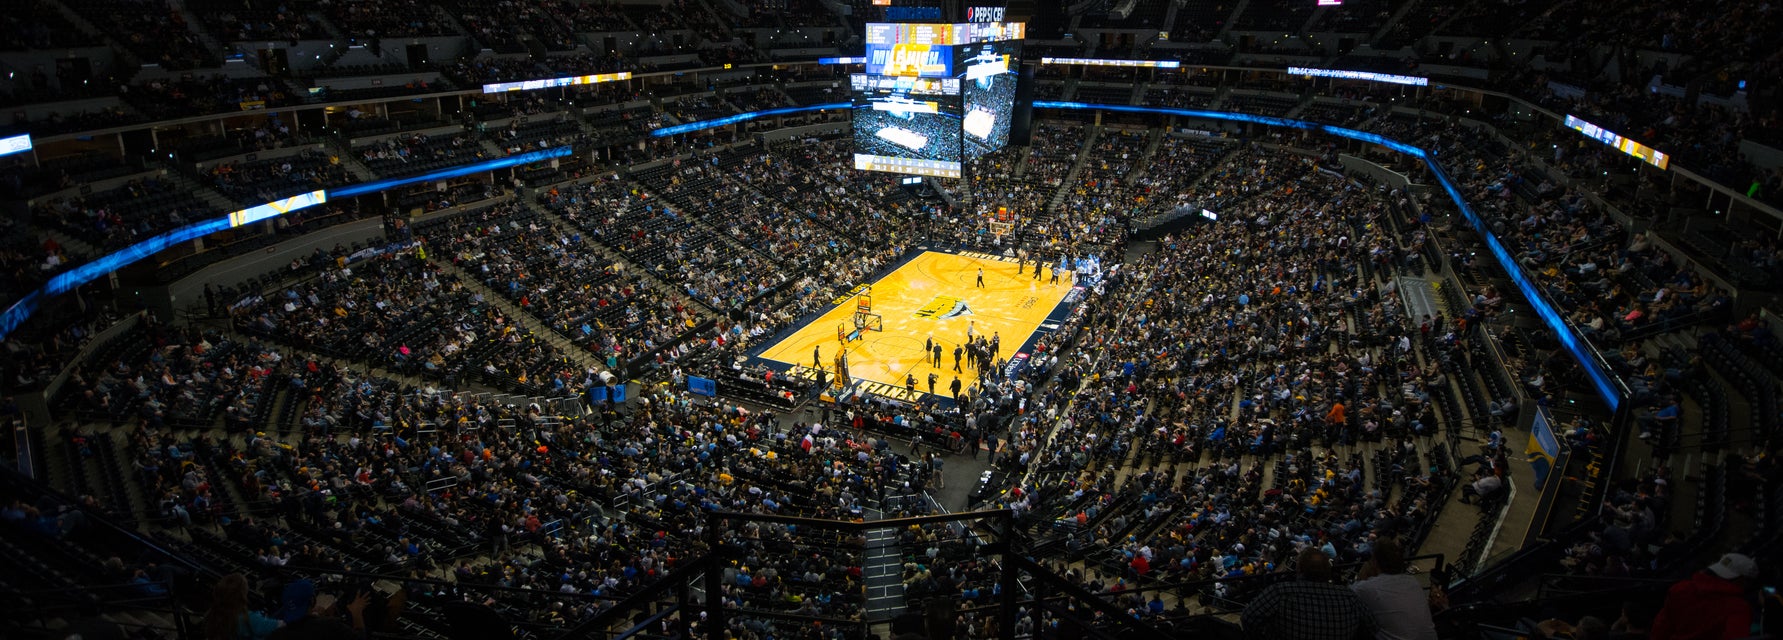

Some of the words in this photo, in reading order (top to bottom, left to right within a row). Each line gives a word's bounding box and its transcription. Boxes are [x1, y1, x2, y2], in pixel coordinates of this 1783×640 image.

[974, 6, 993, 22] PEPSI
[958, 250, 1001, 261] DENVER
[856, 380, 924, 402] DENVER
